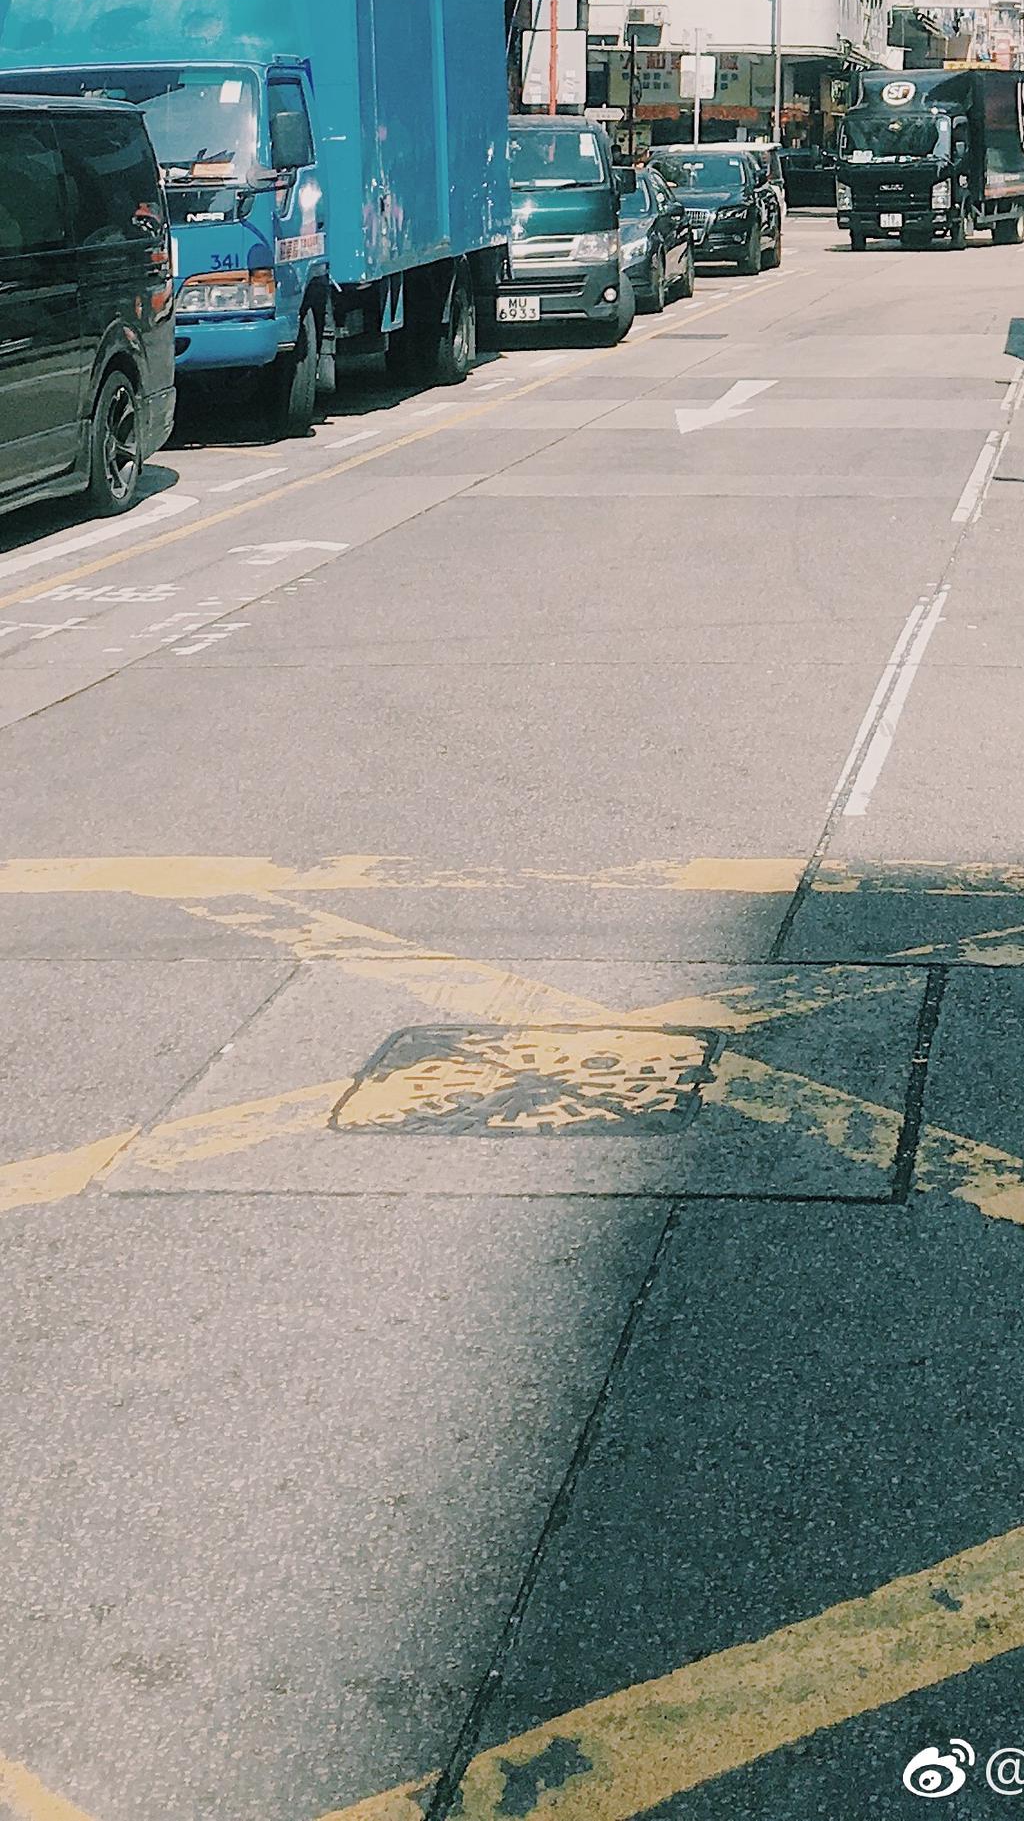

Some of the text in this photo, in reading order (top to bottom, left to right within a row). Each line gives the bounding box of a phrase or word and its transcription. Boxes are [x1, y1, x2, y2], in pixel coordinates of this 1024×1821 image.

[186, 213, 226, 223] NPR
[210, 253, 240, 270] 341
[508, 298, 527, 308] MU
[499, 308, 537, 319] 6933
